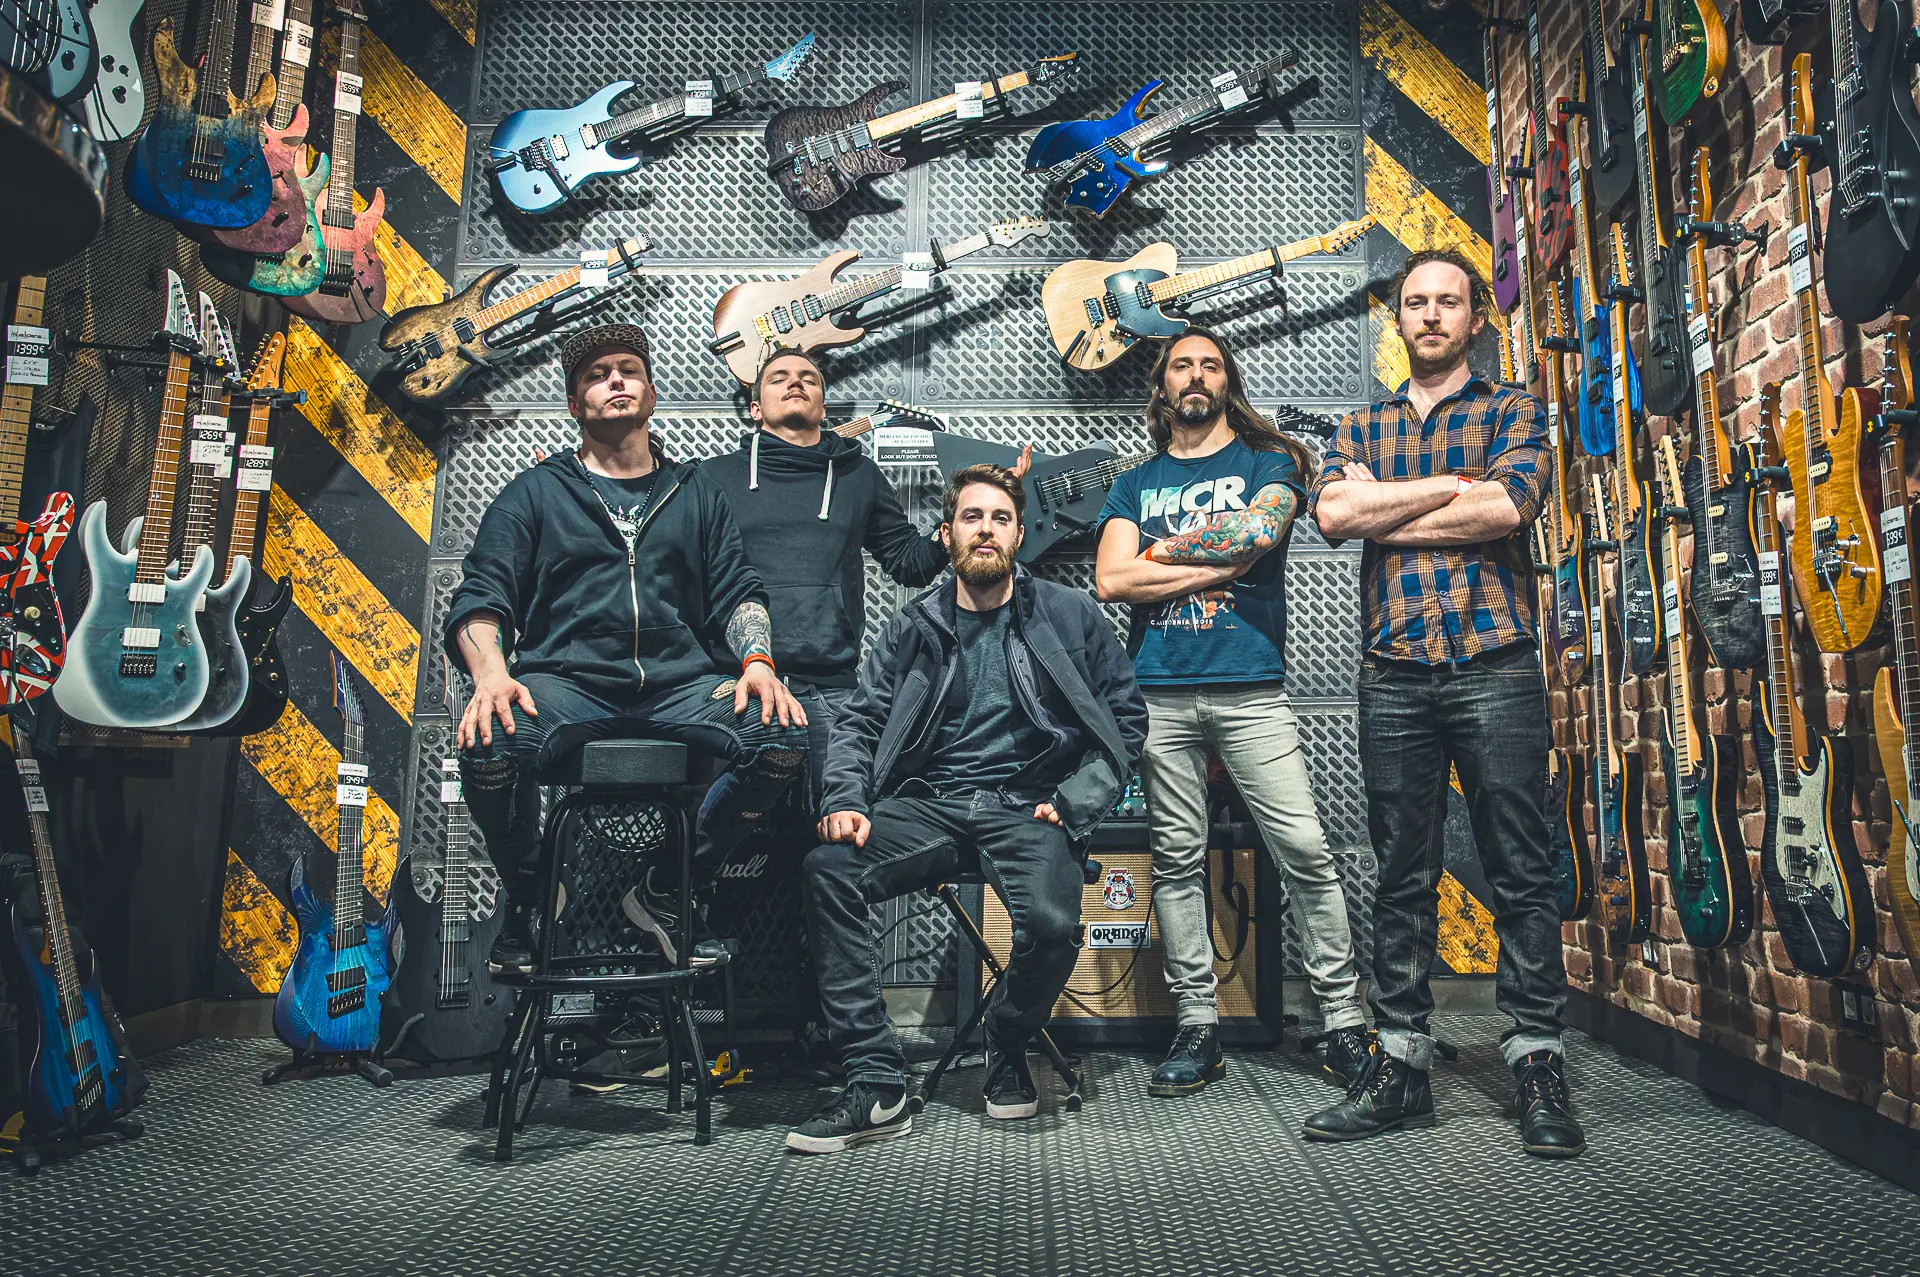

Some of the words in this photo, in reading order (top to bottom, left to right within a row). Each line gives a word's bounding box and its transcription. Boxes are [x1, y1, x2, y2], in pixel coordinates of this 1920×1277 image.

[16, 343, 45, 356] 1399€
[1140, 475, 1248, 525] MCR
[345, 776, 365, 784] 949€
